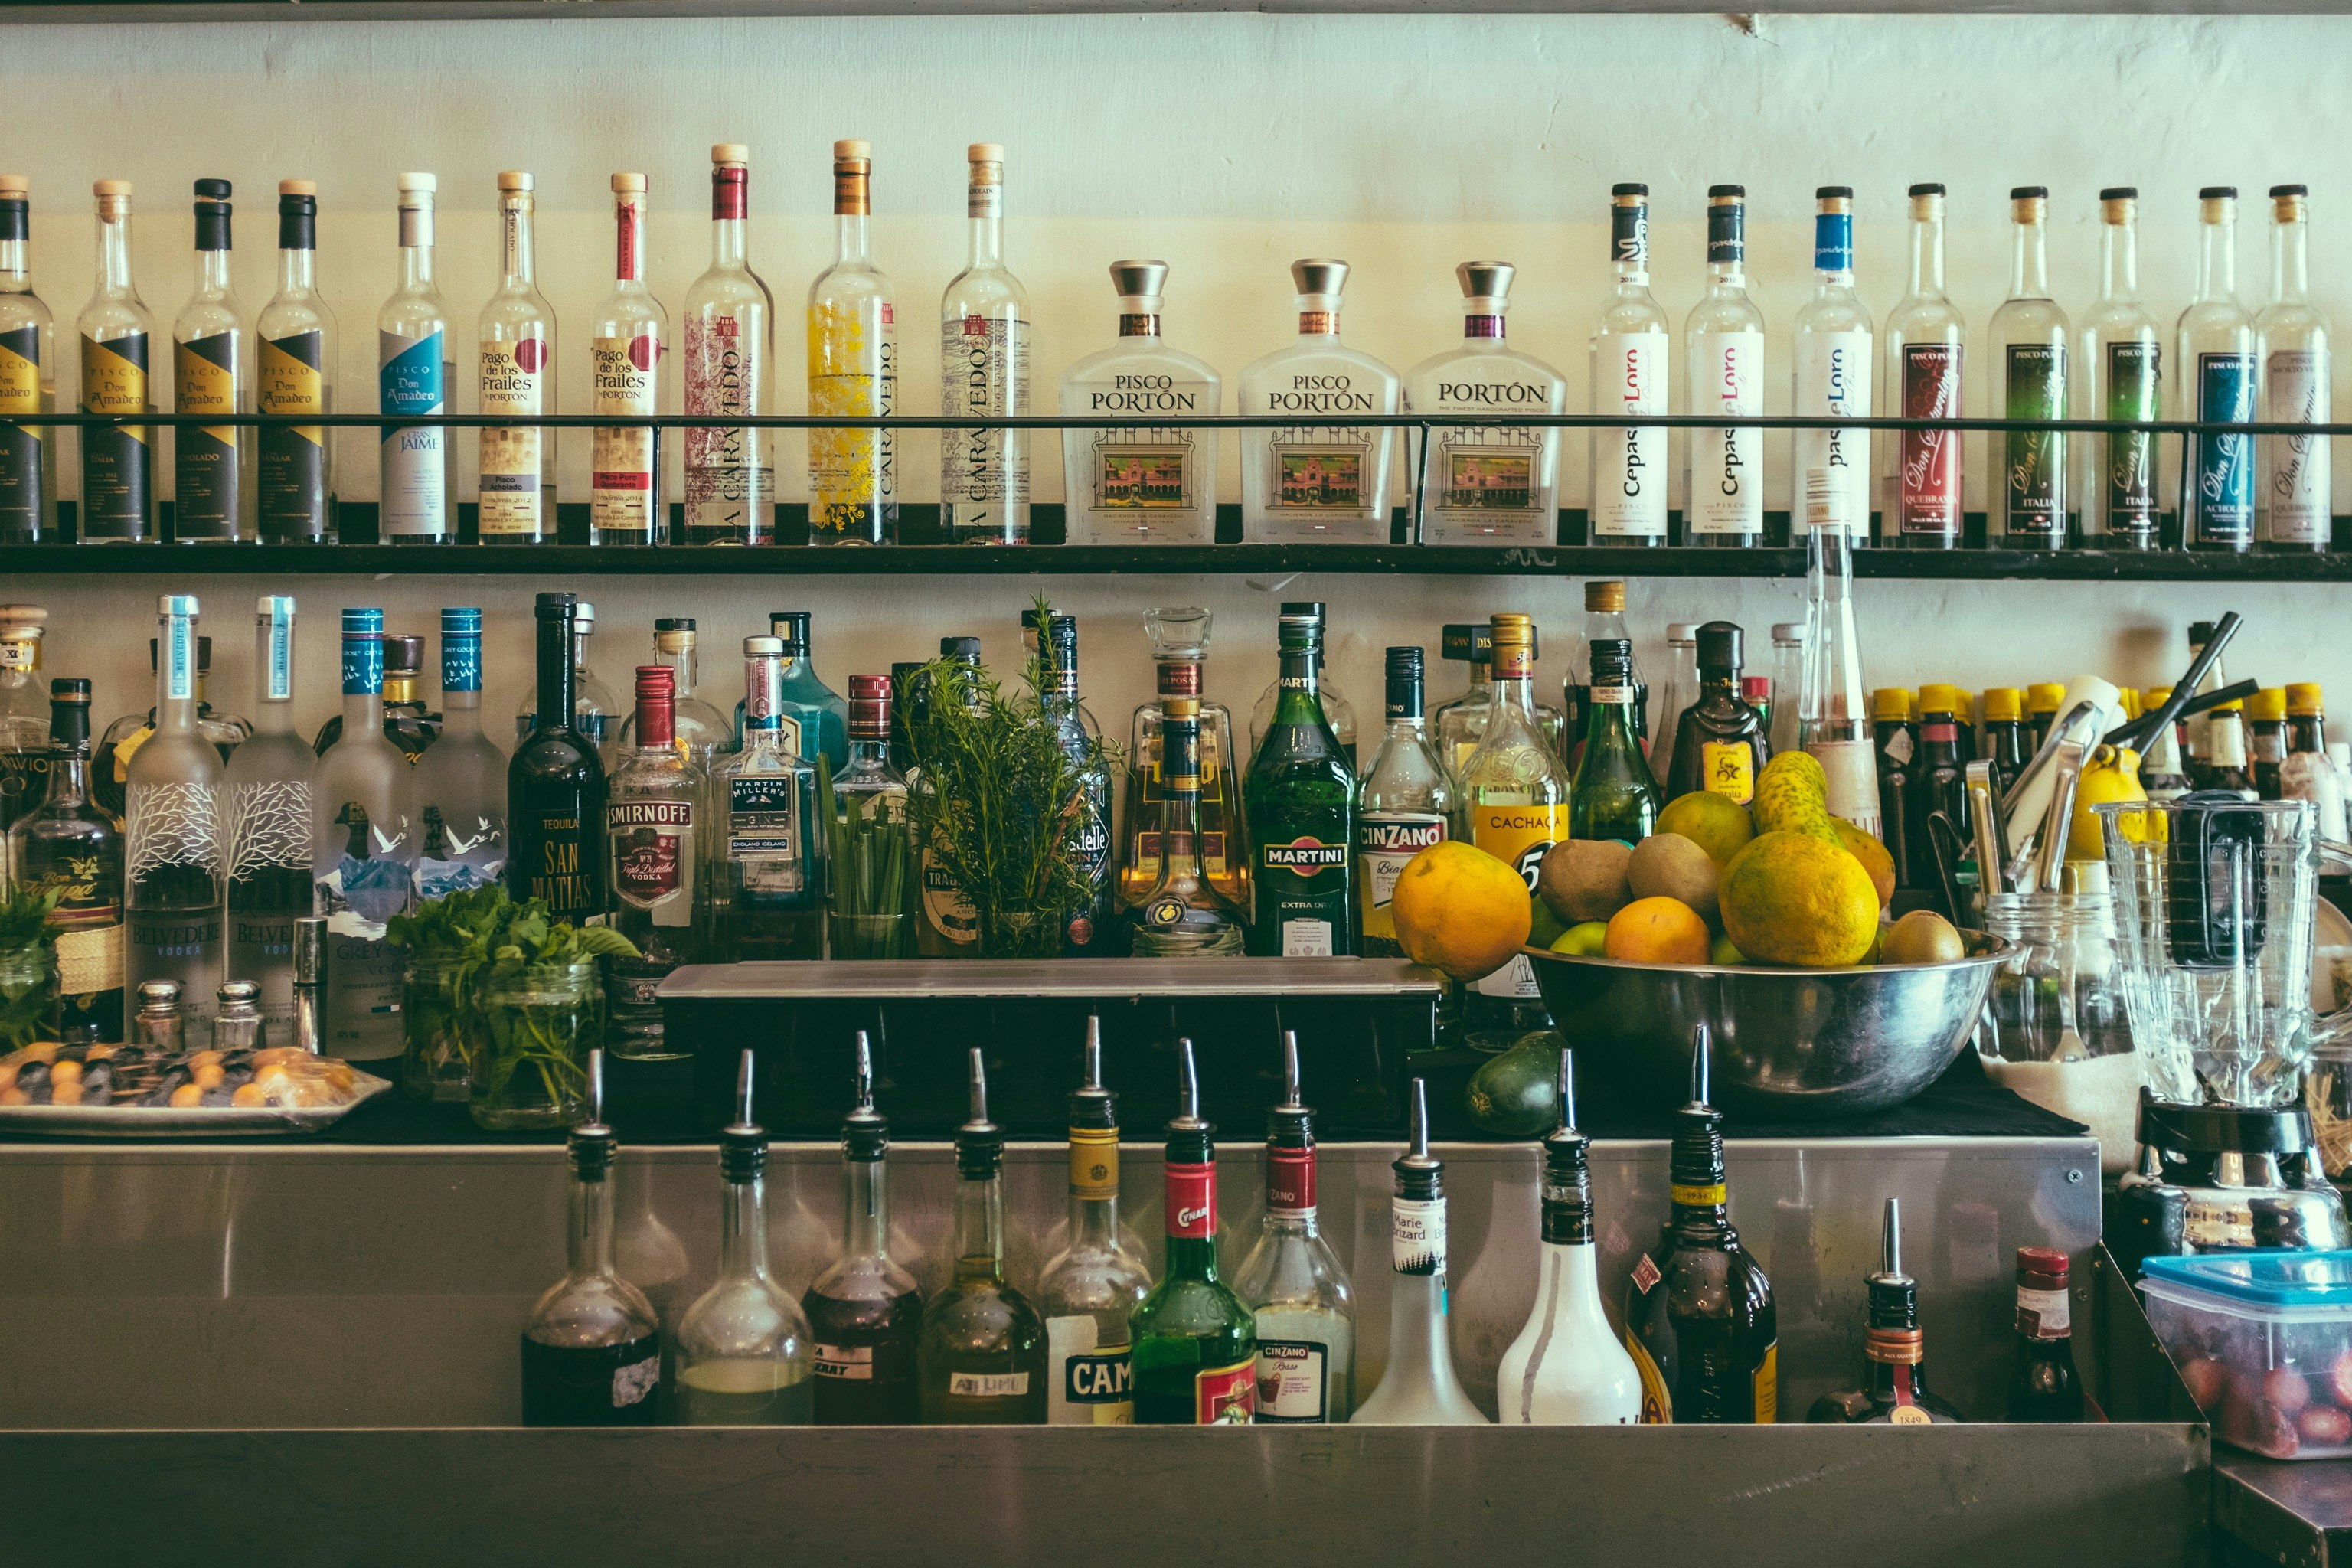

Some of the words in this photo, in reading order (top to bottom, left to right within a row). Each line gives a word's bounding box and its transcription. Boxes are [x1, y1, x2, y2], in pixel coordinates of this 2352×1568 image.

[482, 352, 510, 365] Pago
[596, 350, 624, 361] Pago
[90, 368, 139, 377] PISCO
[177, 368, 220, 376] PISCO
[263, 367, 309, 375] PISCO
[486, 365, 498, 375] de
[501, 365, 518, 375] los
[599, 363, 612, 372] de
[615, 363, 632, 373] los
[104, 381, 126, 393] Don
[186, 381, 206, 392] Don
[275, 381, 296, 391] Don
[398, 377, 419, 389] Don
[482, 376, 532, 390] Frailes
[596, 374, 645, 388] Frailes
[1115, 375, 1172, 390] PISCO
[1293, 375, 1351, 390] PISCO
[91, 392, 141, 408] Amadeo
[178, 392, 223, 408] Amadeo
[263, 391, 312, 407] Amadeo
[388, 388, 435, 404] Amadeo
[1091, 390, 1196, 412] PORTÓN
[1269, 390, 1374, 413] PORTÓN
[407, 430, 431, 440] GRAN
[400, 436, 439, 453] JAIME
[1905, 449, 1930, 492] Don
[2011, 452, 2037, 495] Don
[2202, 459, 2229, 501] Don
[2275, 459, 2300, 499] Don
[1905, 495, 1958, 505] QUEBRAA
[2205, 505, 2252, 513] ACHOLA
[175, 622, 185, 671] BELVEDERE
[277, 622, 286, 670] BELVEDERE
[1476, 636, 1492, 648] DIS
[733, 787, 786, 798] MILLER'S
[611, 805, 688, 824] SMIRNOFF
[748, 815, 771, 825] GIN
[544, 819, 580, 830] TEQUILA
[1072, 826, 1106, 851] delle
[1360, 825, 1440, 849] CINZANO
[545, 841, 578, 875] SAN
[1269, 850, 1342, 863] MARTINI
[43, 871, 72, 882] Ron
[621, 863, 640, 877] Triple
[640, 862, 676, 874] Distilled
[1521, 850, 1544, 892] 5
[24, 880, 98, 905] Zapa
[532, 874, 592, 910] MATIAS
[133, 923, 219, 945] BELVEDERE
[158, 945, 201, 956] VODKA
[264, 945, 288, 954] VOD
[337, 943, 383, 960] GREY
[368, 963, 401, 975] VOD
[1178, 1206, 1208, 1228] CYNAR
[1393, 1214, 1423, 1229] Marie
[1393, 1224, 1426, 1240] Brizard
[1265, 1347, 1306, 1357] CINZANO
[1272, 1361, 1298, 1371] Rosso
[1073, 1361, 1132, 1395] CAM
